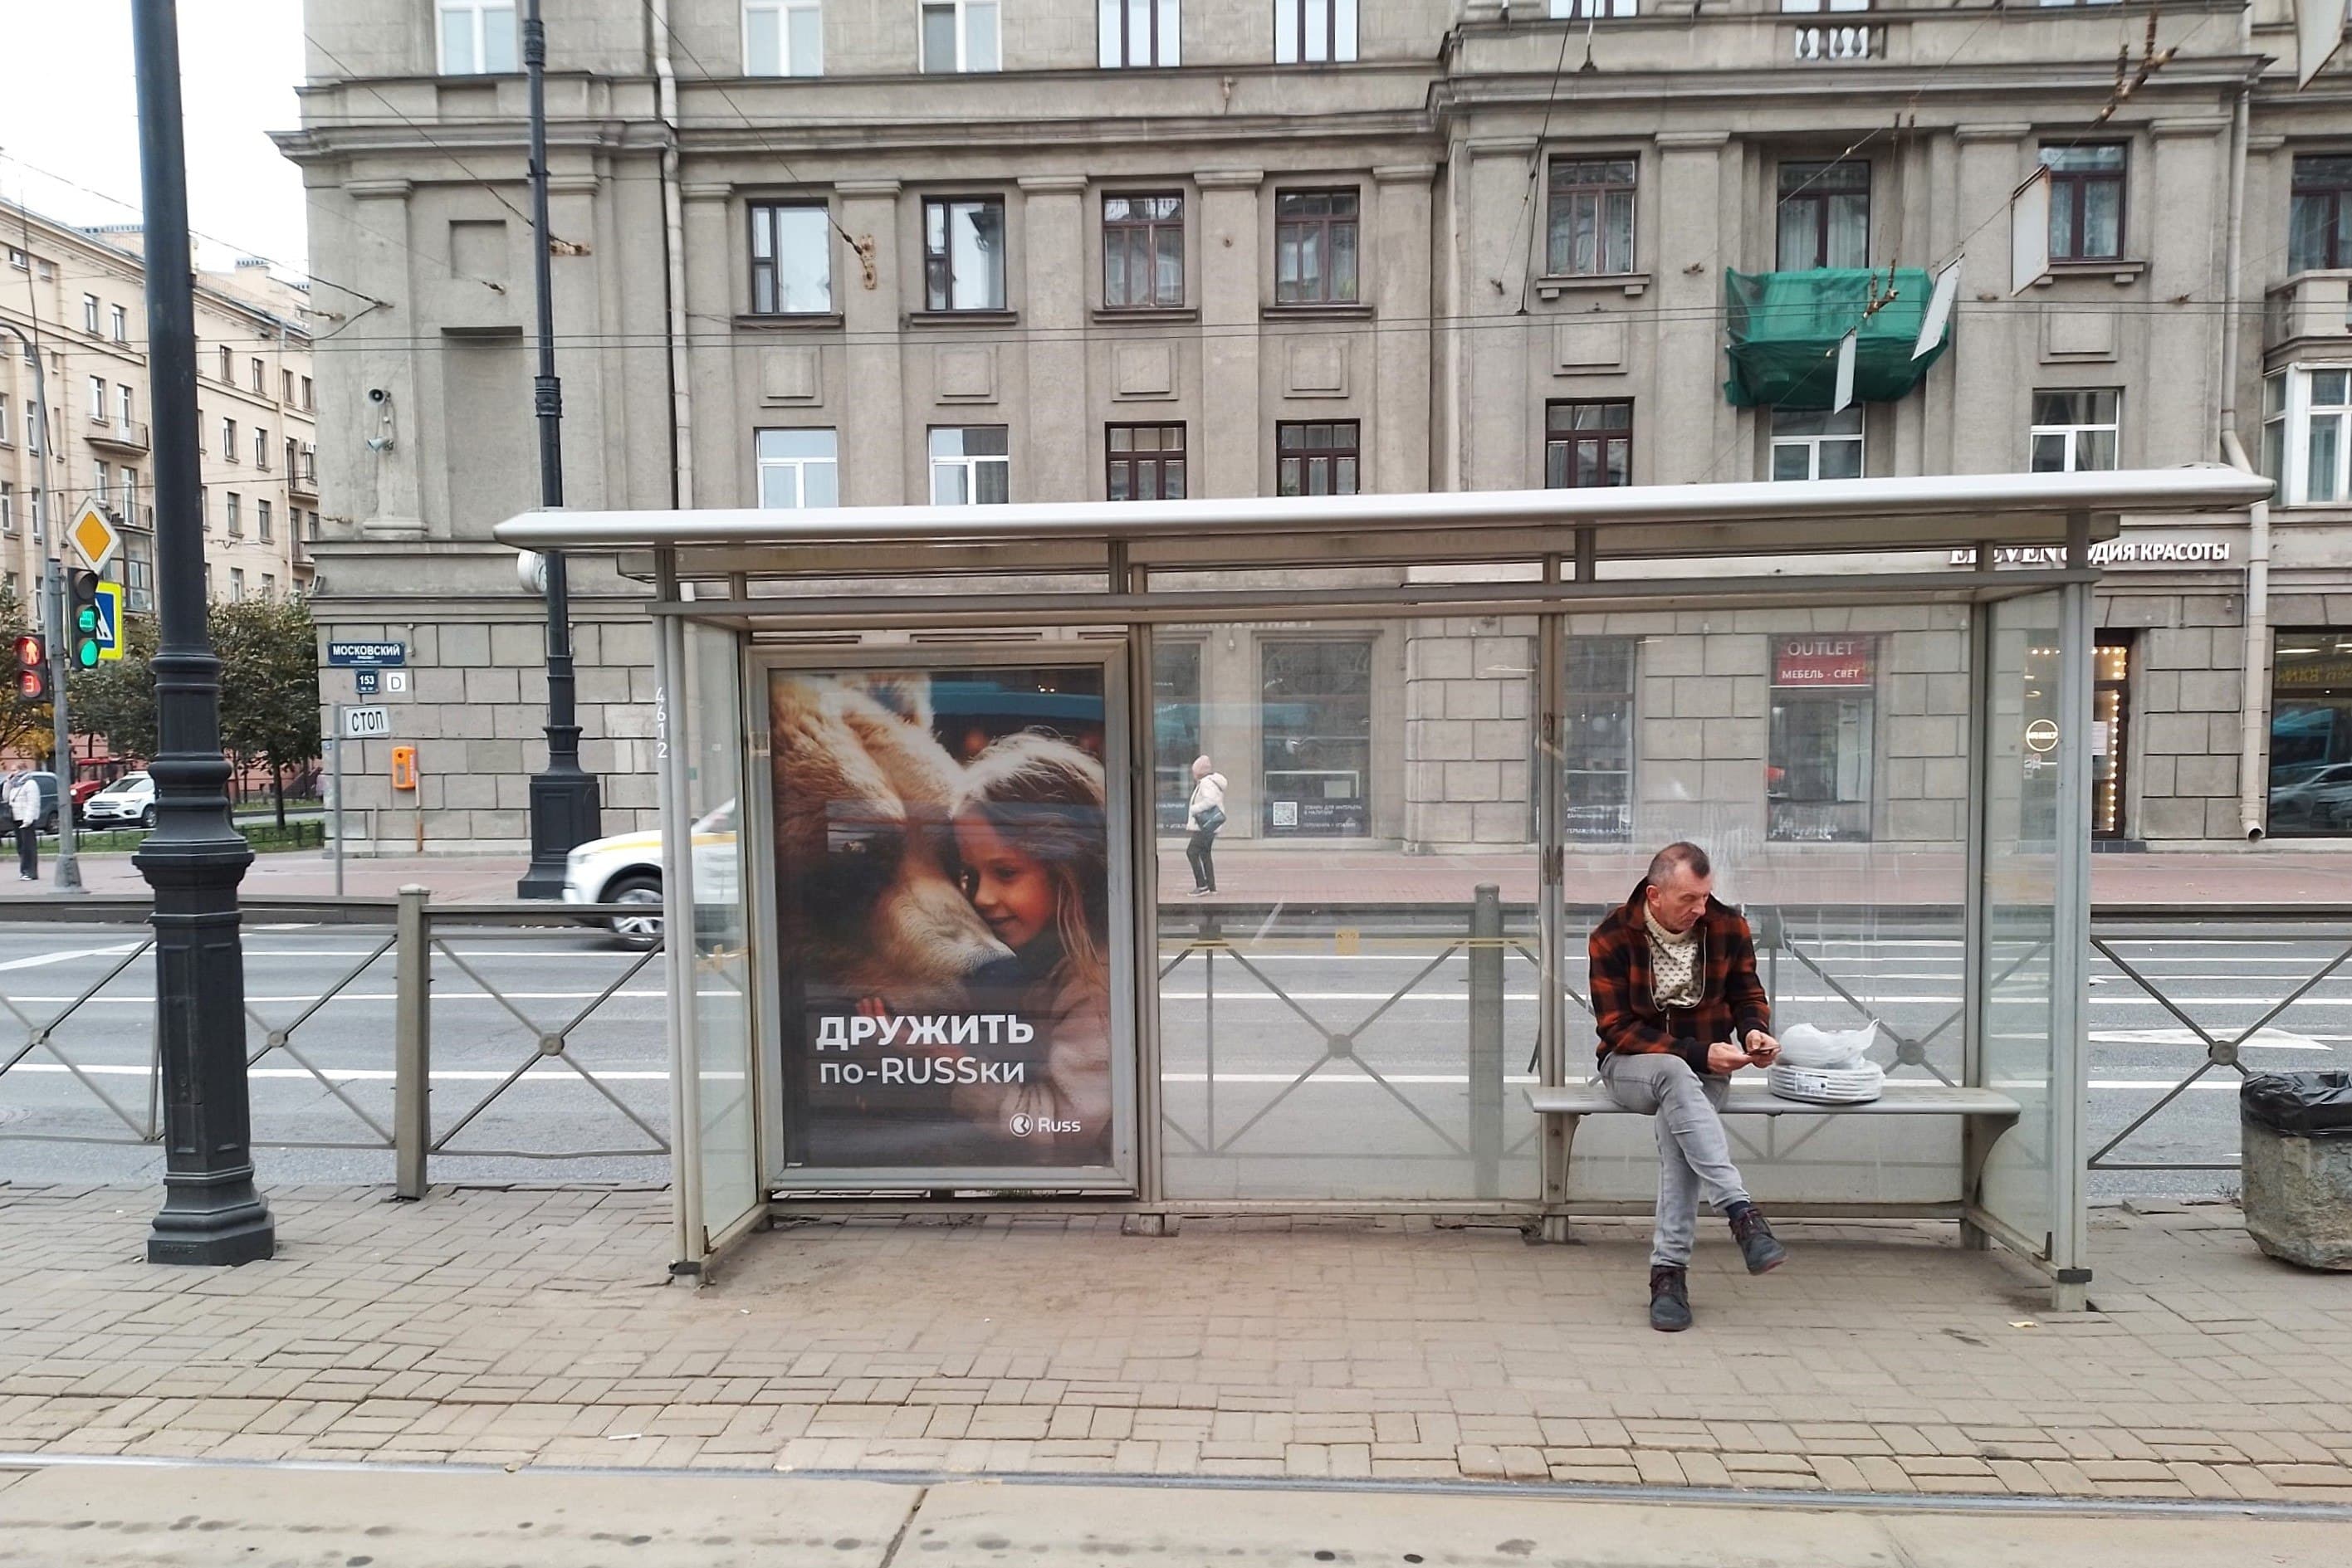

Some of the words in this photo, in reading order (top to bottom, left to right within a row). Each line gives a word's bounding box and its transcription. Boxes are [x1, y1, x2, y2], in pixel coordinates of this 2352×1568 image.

[2140, 543, 2230, 561] КРАСОТЫ
[332, 644, 401, 656] МОСКОВСКИЙ
[1787, 641, 1855, 656] OUTLET
[359, 675, 374, 685] 153
[1782, 669, 1824, 679] МЕБЕЛЬ
[1833, 668, 1860, 678] СВЕТ
[25, 675, 35, 693] 3
[390, 677, 402, 690] D
[351, 711, 384, 732] СТОП
[655, 686, 668, 759] 4612
[815, 1014, 1034, 1052] ДРУЖИТЬ
[819, 1056, 1024, 1084] по-RUSSки
[1038, 1117, 1082, 1133] Russ
